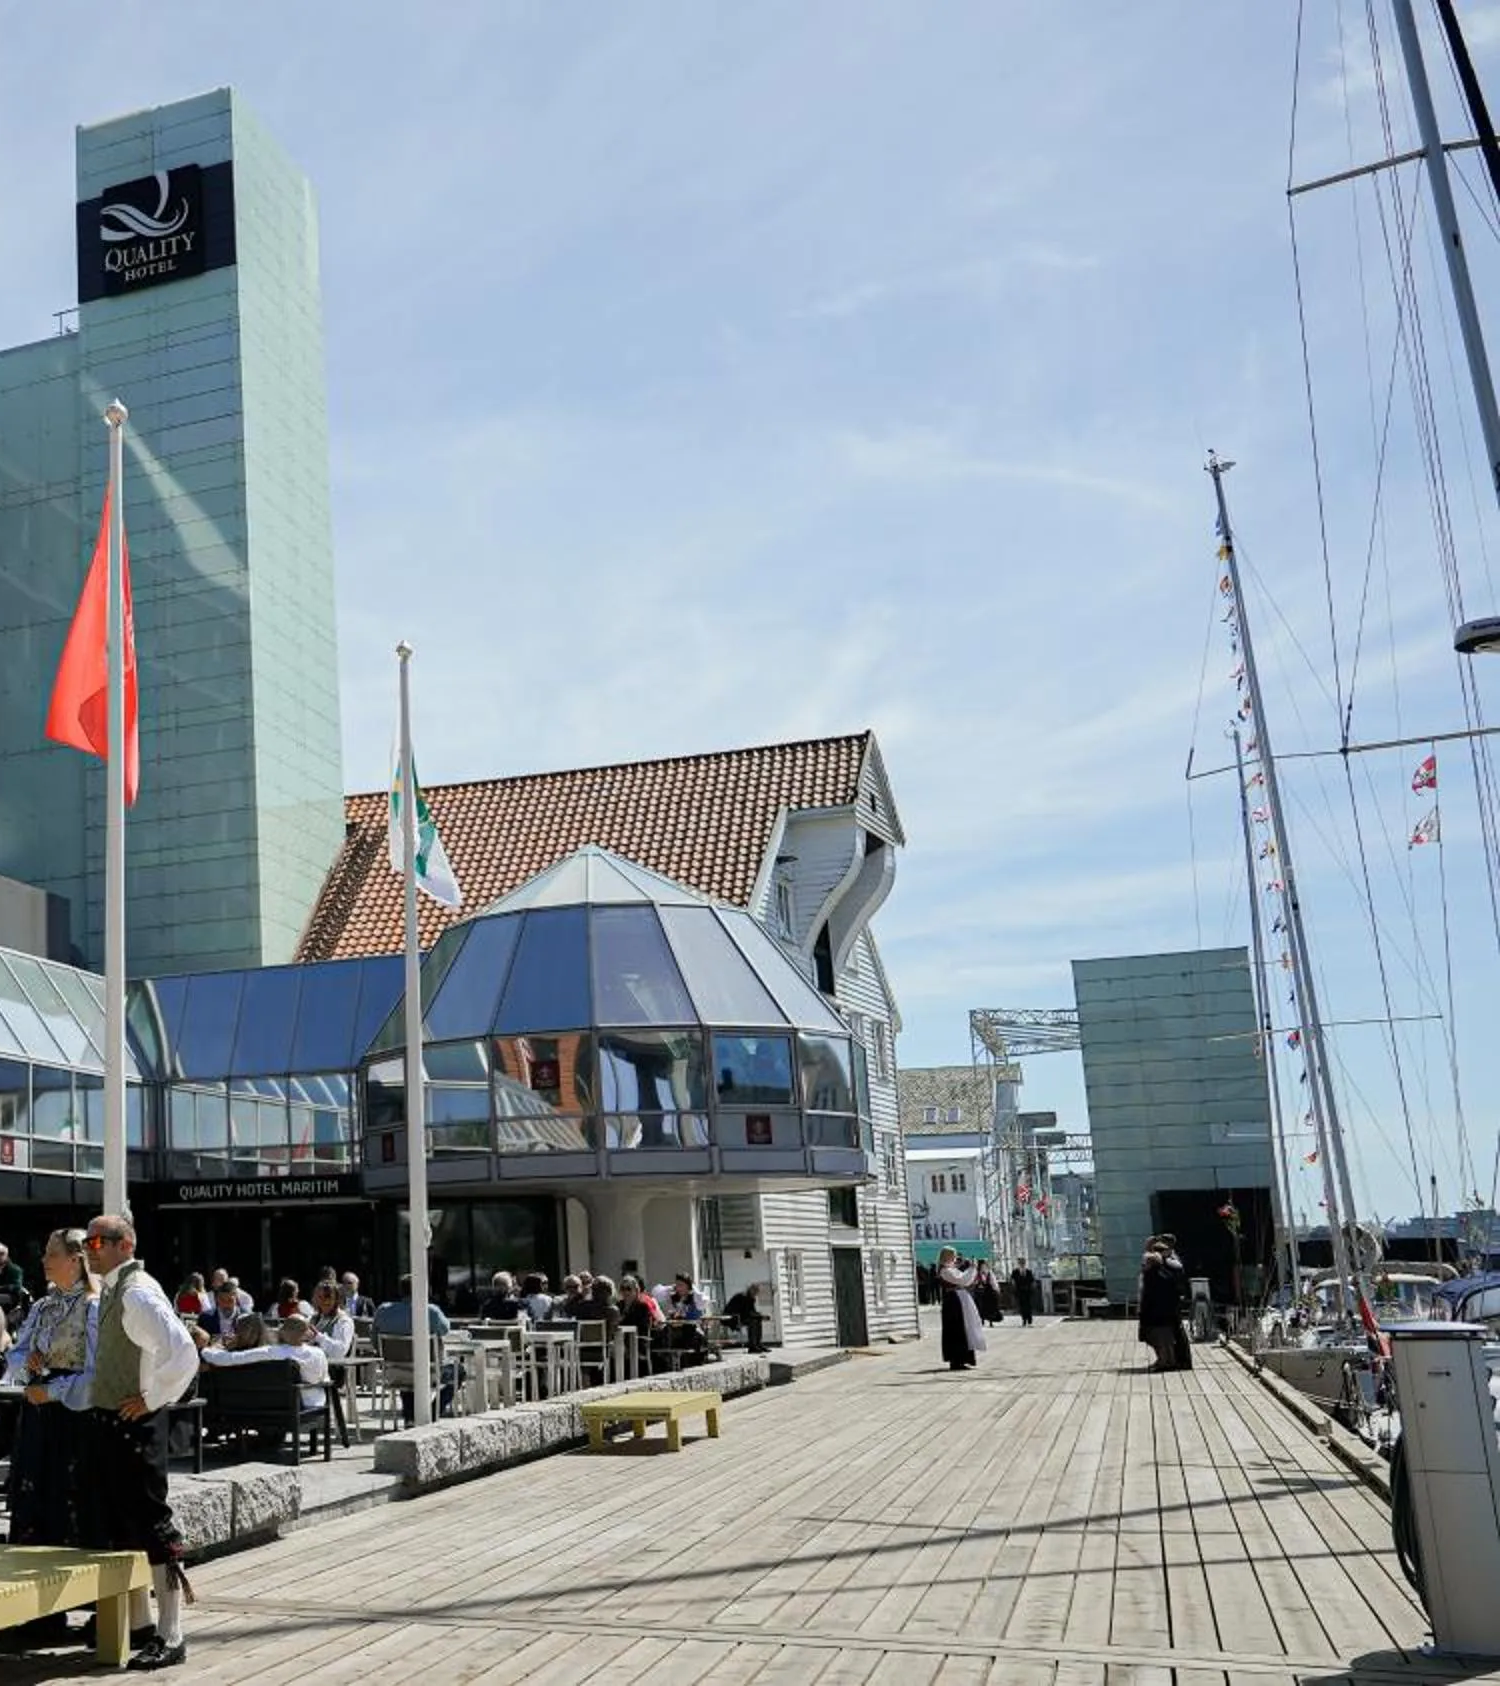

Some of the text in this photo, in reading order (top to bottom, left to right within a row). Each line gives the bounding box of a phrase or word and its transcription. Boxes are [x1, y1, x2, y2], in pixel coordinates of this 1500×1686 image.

[105, 232, 195, 272] QUALITY
[124, 259, 177, 281] HOTEL
[179, 1180, 339, 1200] QUALITY HOTEL MARITIM
